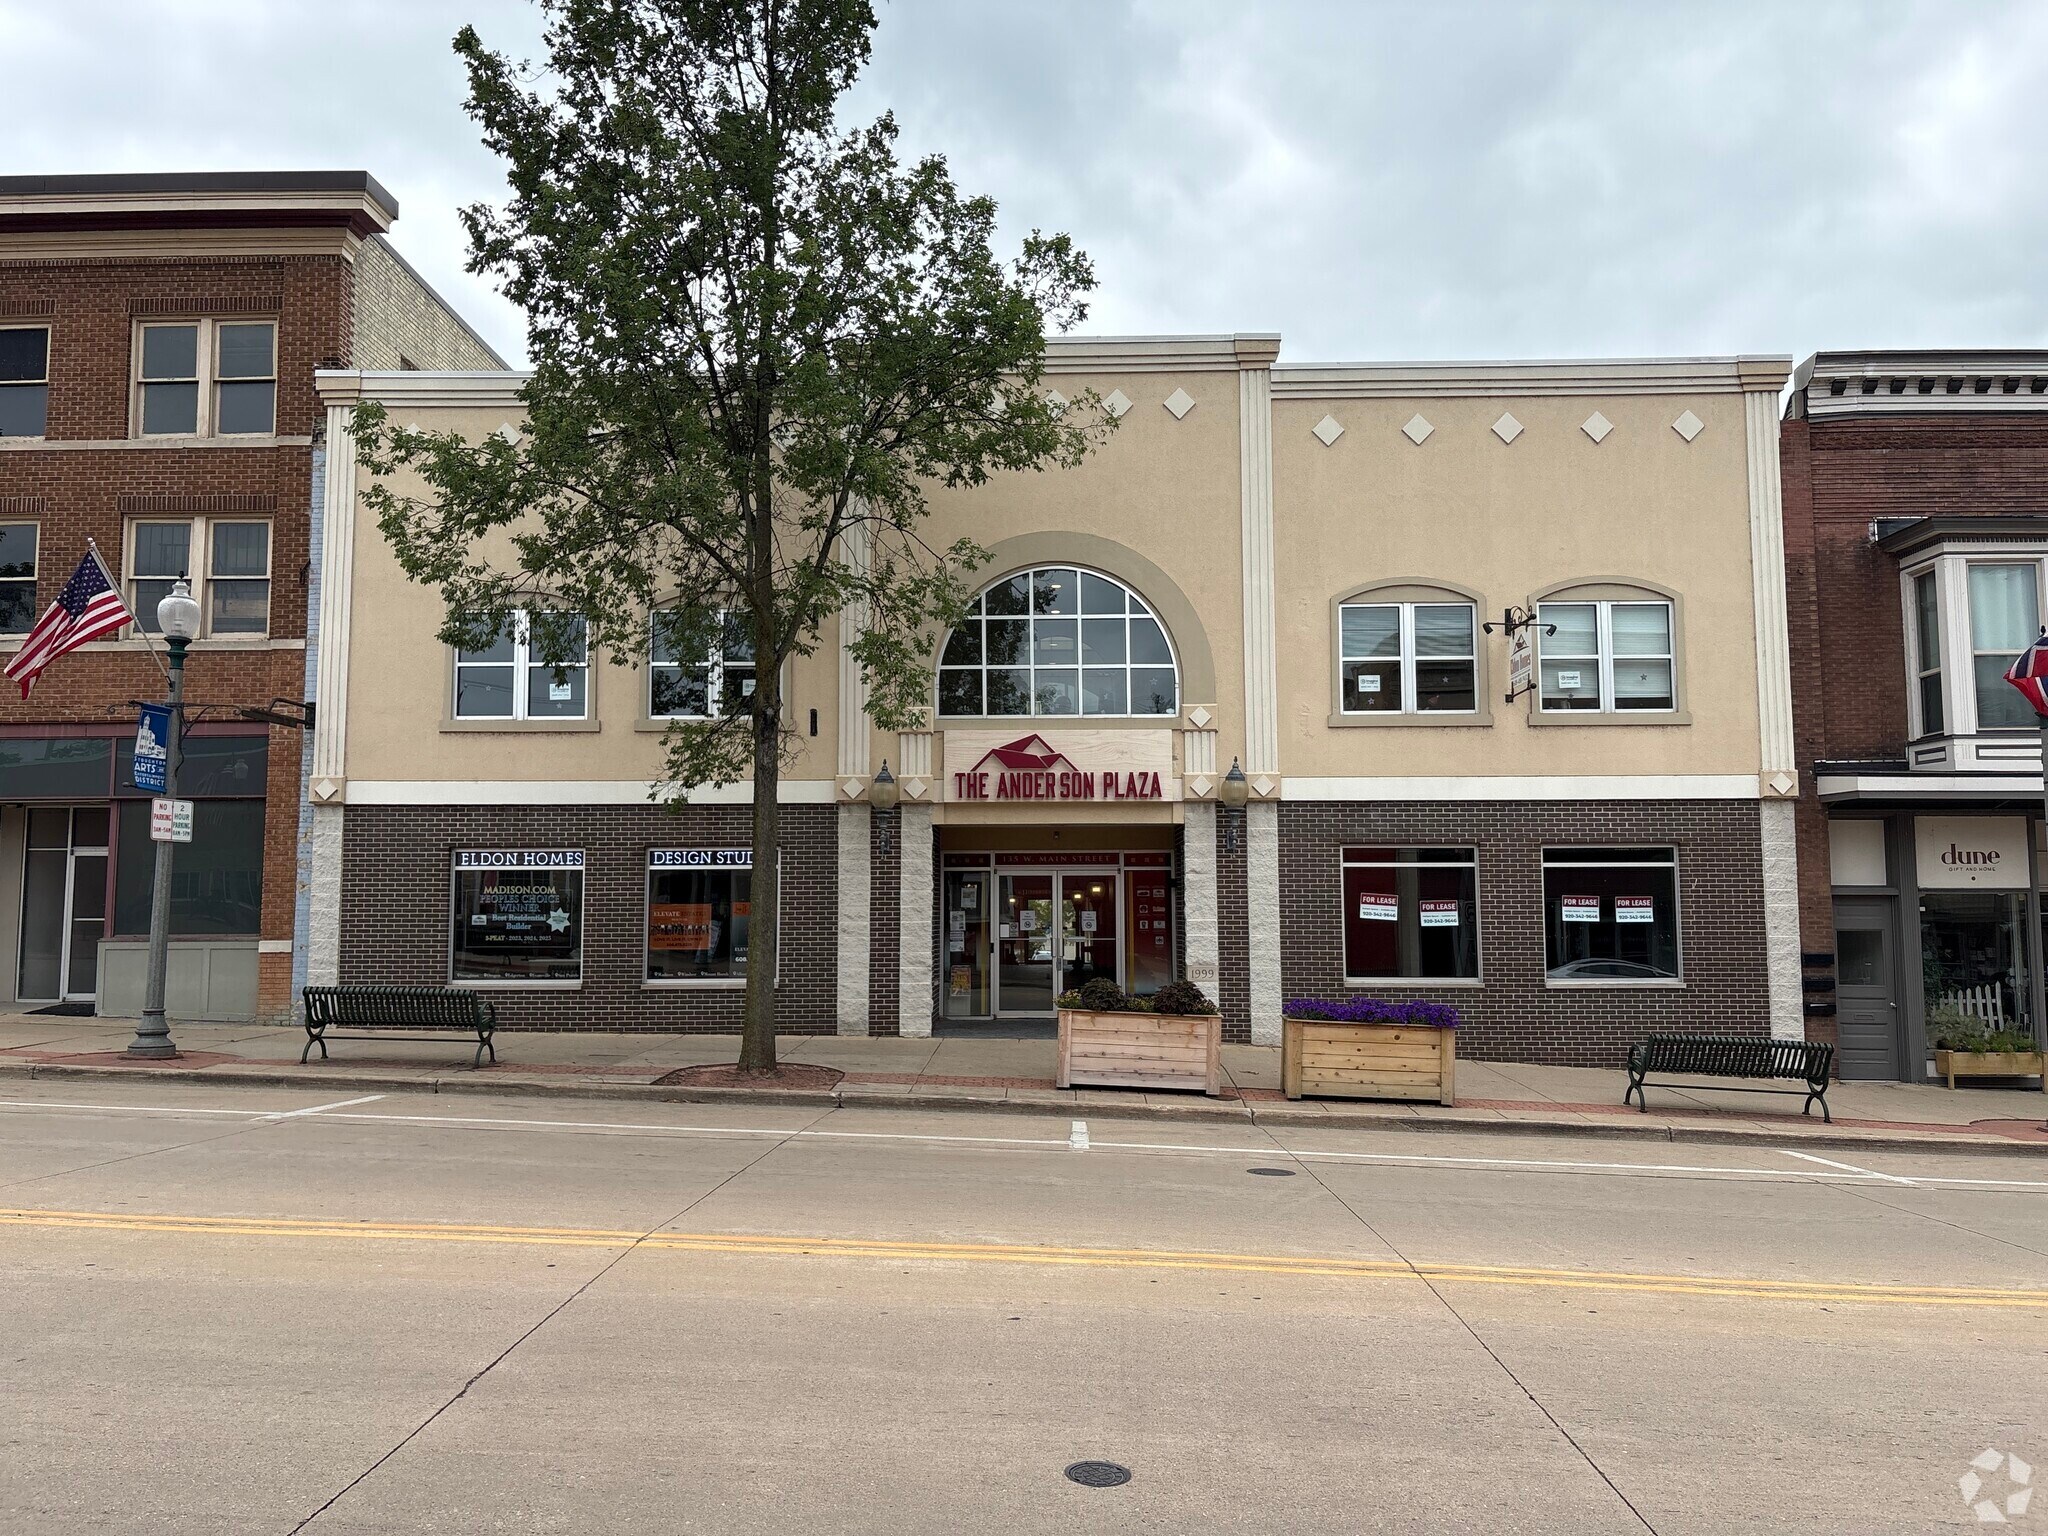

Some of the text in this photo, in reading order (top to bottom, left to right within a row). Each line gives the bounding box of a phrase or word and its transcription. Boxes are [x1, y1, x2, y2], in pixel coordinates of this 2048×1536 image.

[134, 762, 156, 773] ARTS
[135, 776, 164, 786] DISTRICT
[954, 771, 1162, 799] THE ANDERSON PLAZA
[154, 813, 171, 821] PARKING
[461, 852, 582, 865] ELDON HOMES
[653, 851, 753, 864] DESIGN STUD
[1941, 843, 2000, 864] dune
[483, 885, 556, 894] MADISON.COM
[480, 894, 560, 903] PEOPLES CHOICE
[1376, 897, 1396, 905] LEASE
[498, 904, 540, 912] WINNER
[1191, 969, 1214, 979] 1999
